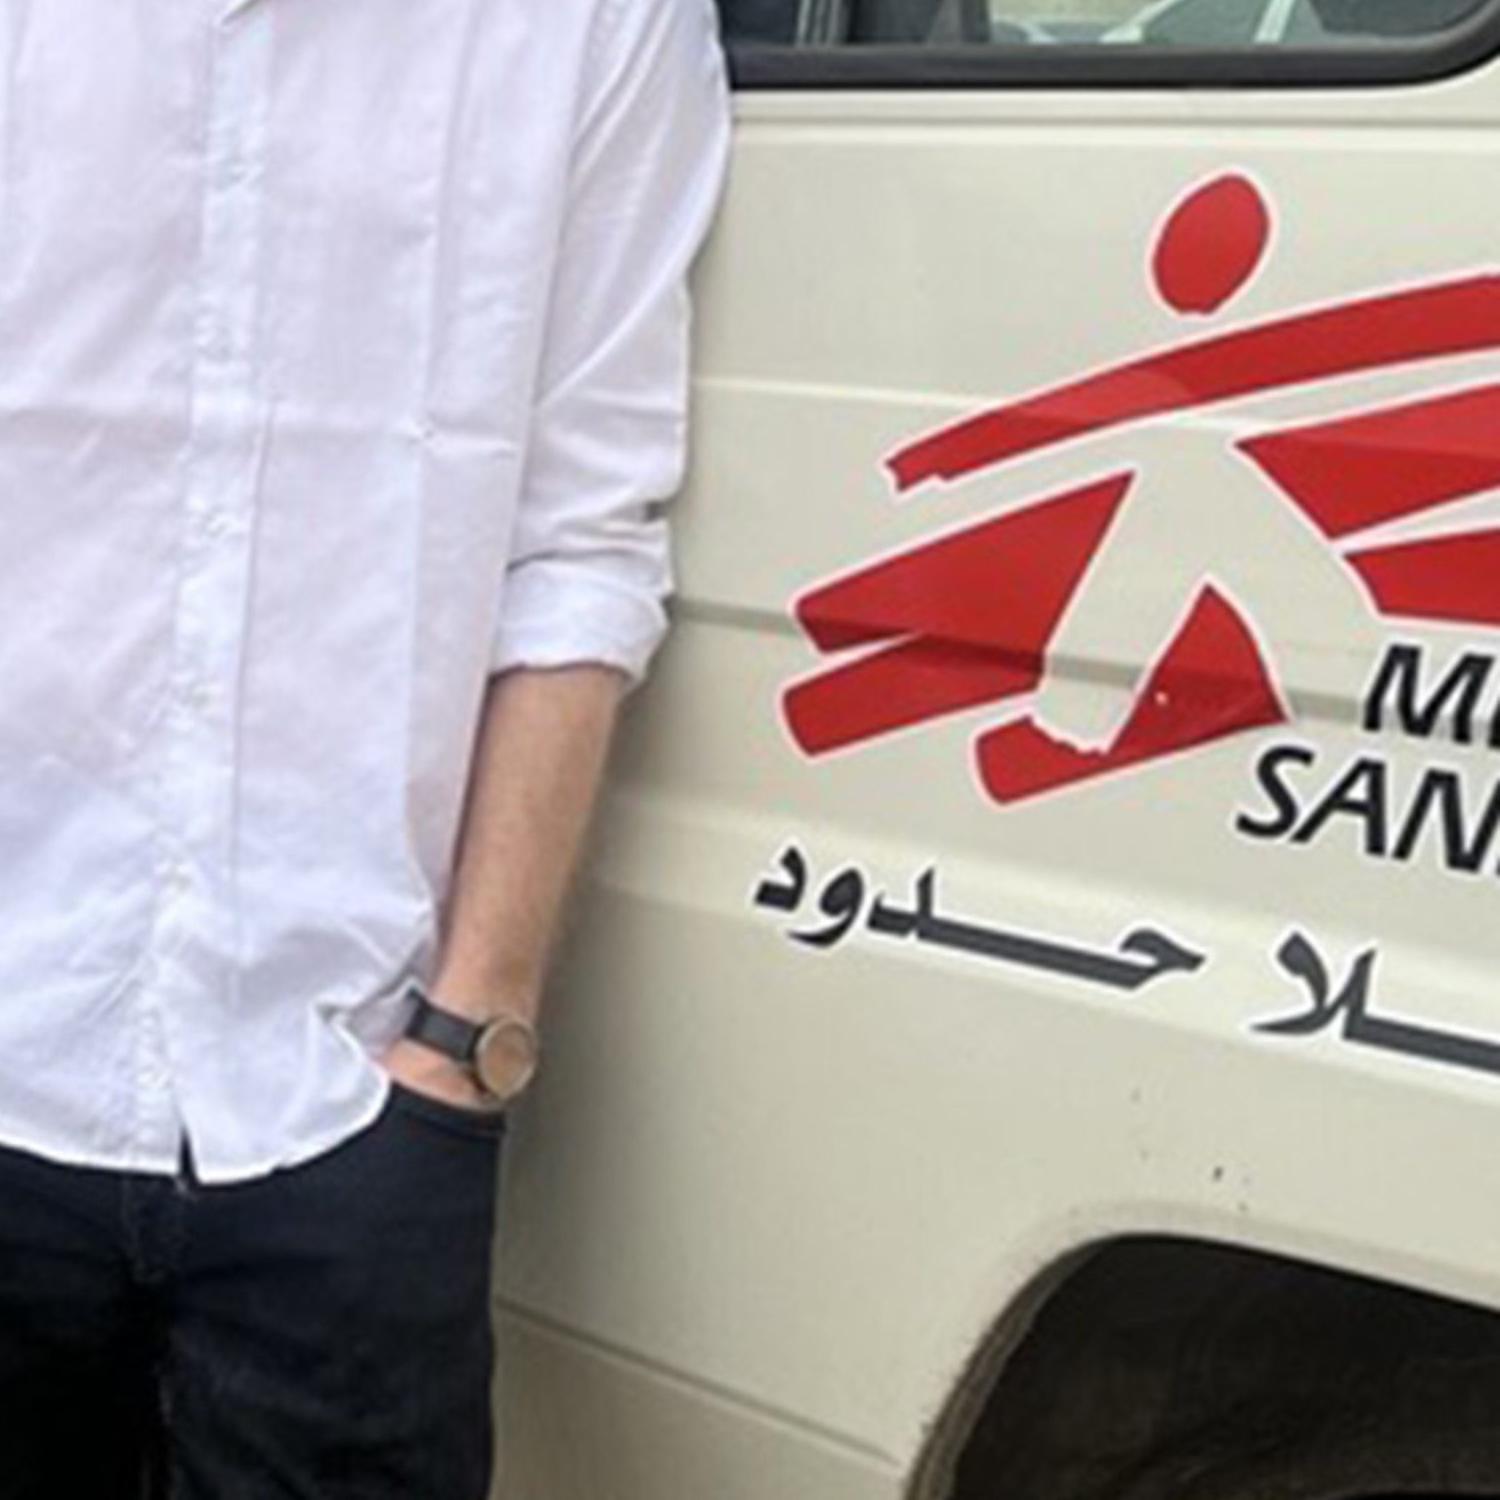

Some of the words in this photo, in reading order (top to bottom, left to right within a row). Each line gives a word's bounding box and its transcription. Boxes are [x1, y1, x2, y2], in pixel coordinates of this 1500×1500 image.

[1363, 643, 1500, 749] M
[1235, 745, 1500, 876] SAN
[754, 846, 1205, 991] حدود
[1252, 932, 1500, 1075] لا
